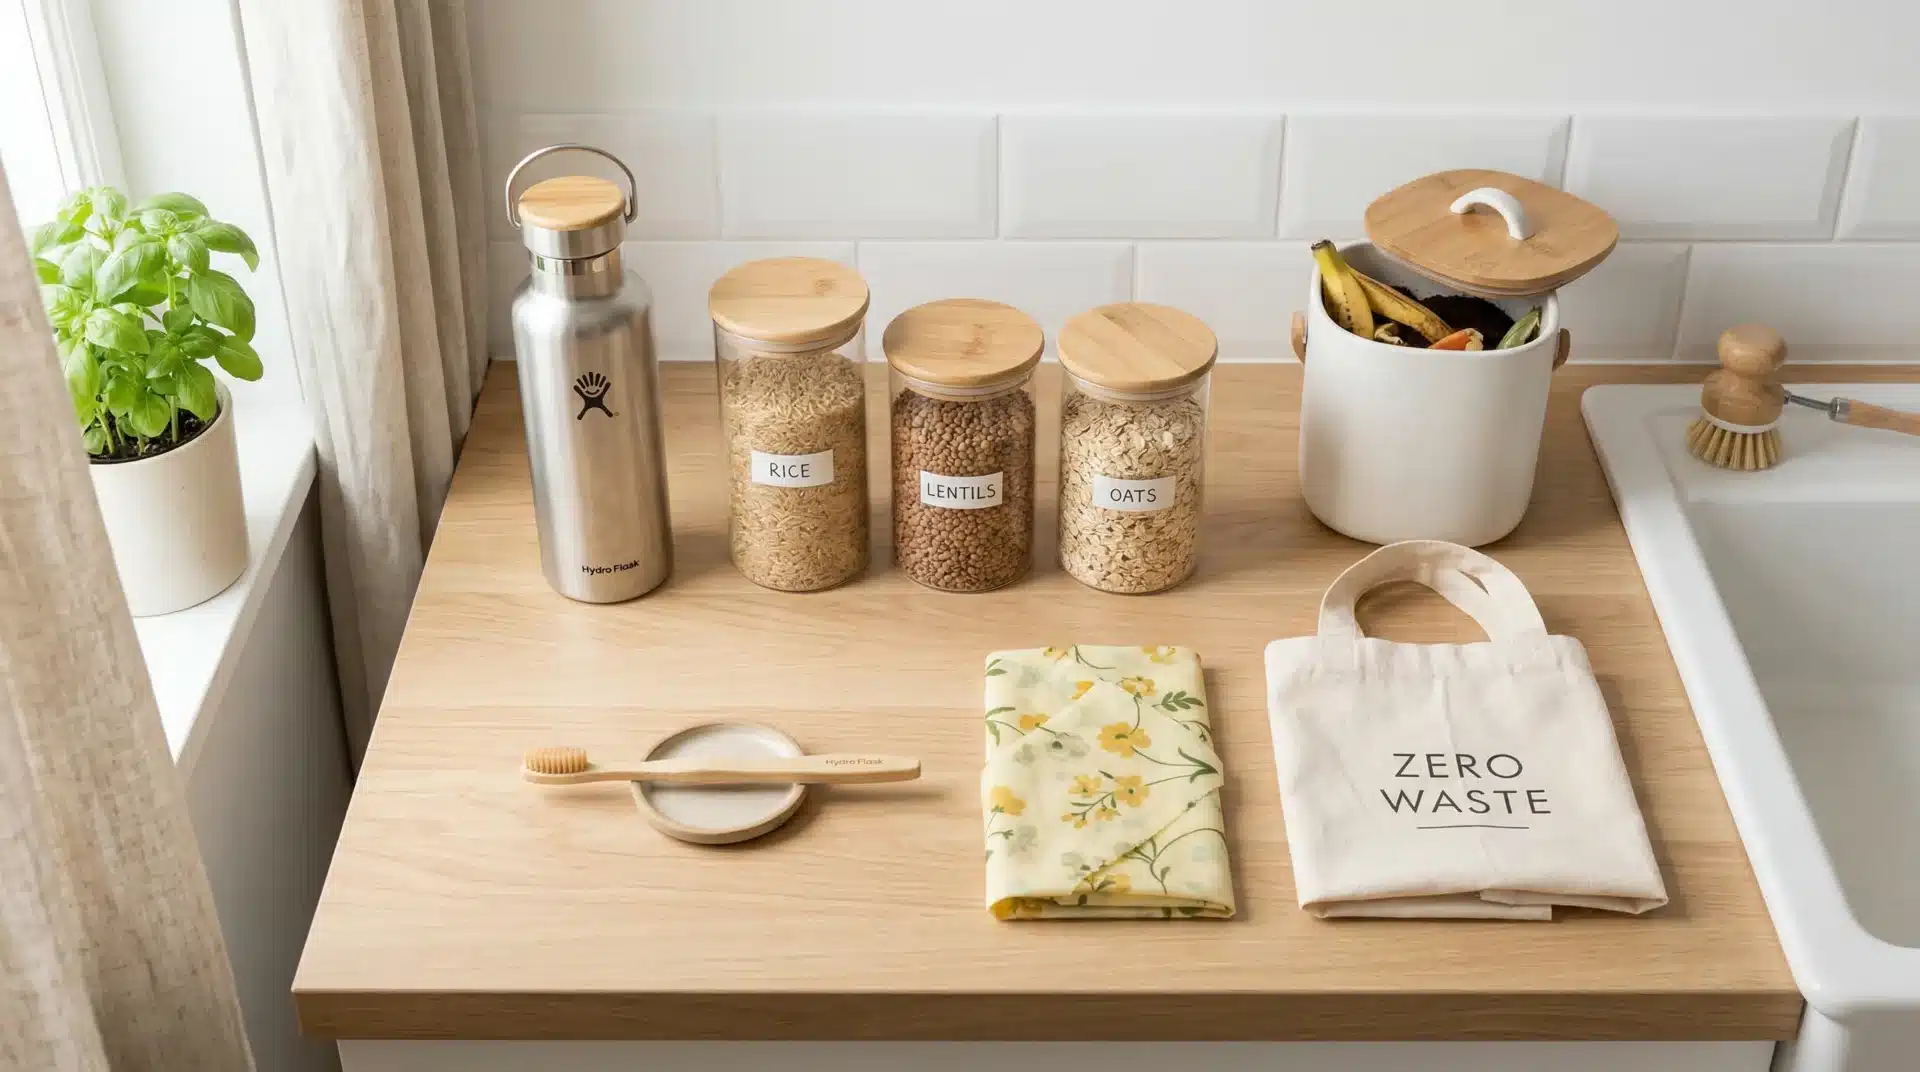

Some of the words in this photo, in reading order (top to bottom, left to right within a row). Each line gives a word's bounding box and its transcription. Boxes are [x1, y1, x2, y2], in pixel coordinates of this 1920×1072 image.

[770, 462, 811, 478] RICE
[927, 482, 996, 500] LENTILS
[1110, 488, 1157, 503] OATS
[582, 565, 612, 575] Hydro
[1393, 753, 1523, 779] ZERO
[1380, 789, 1551, 814] WASTE
